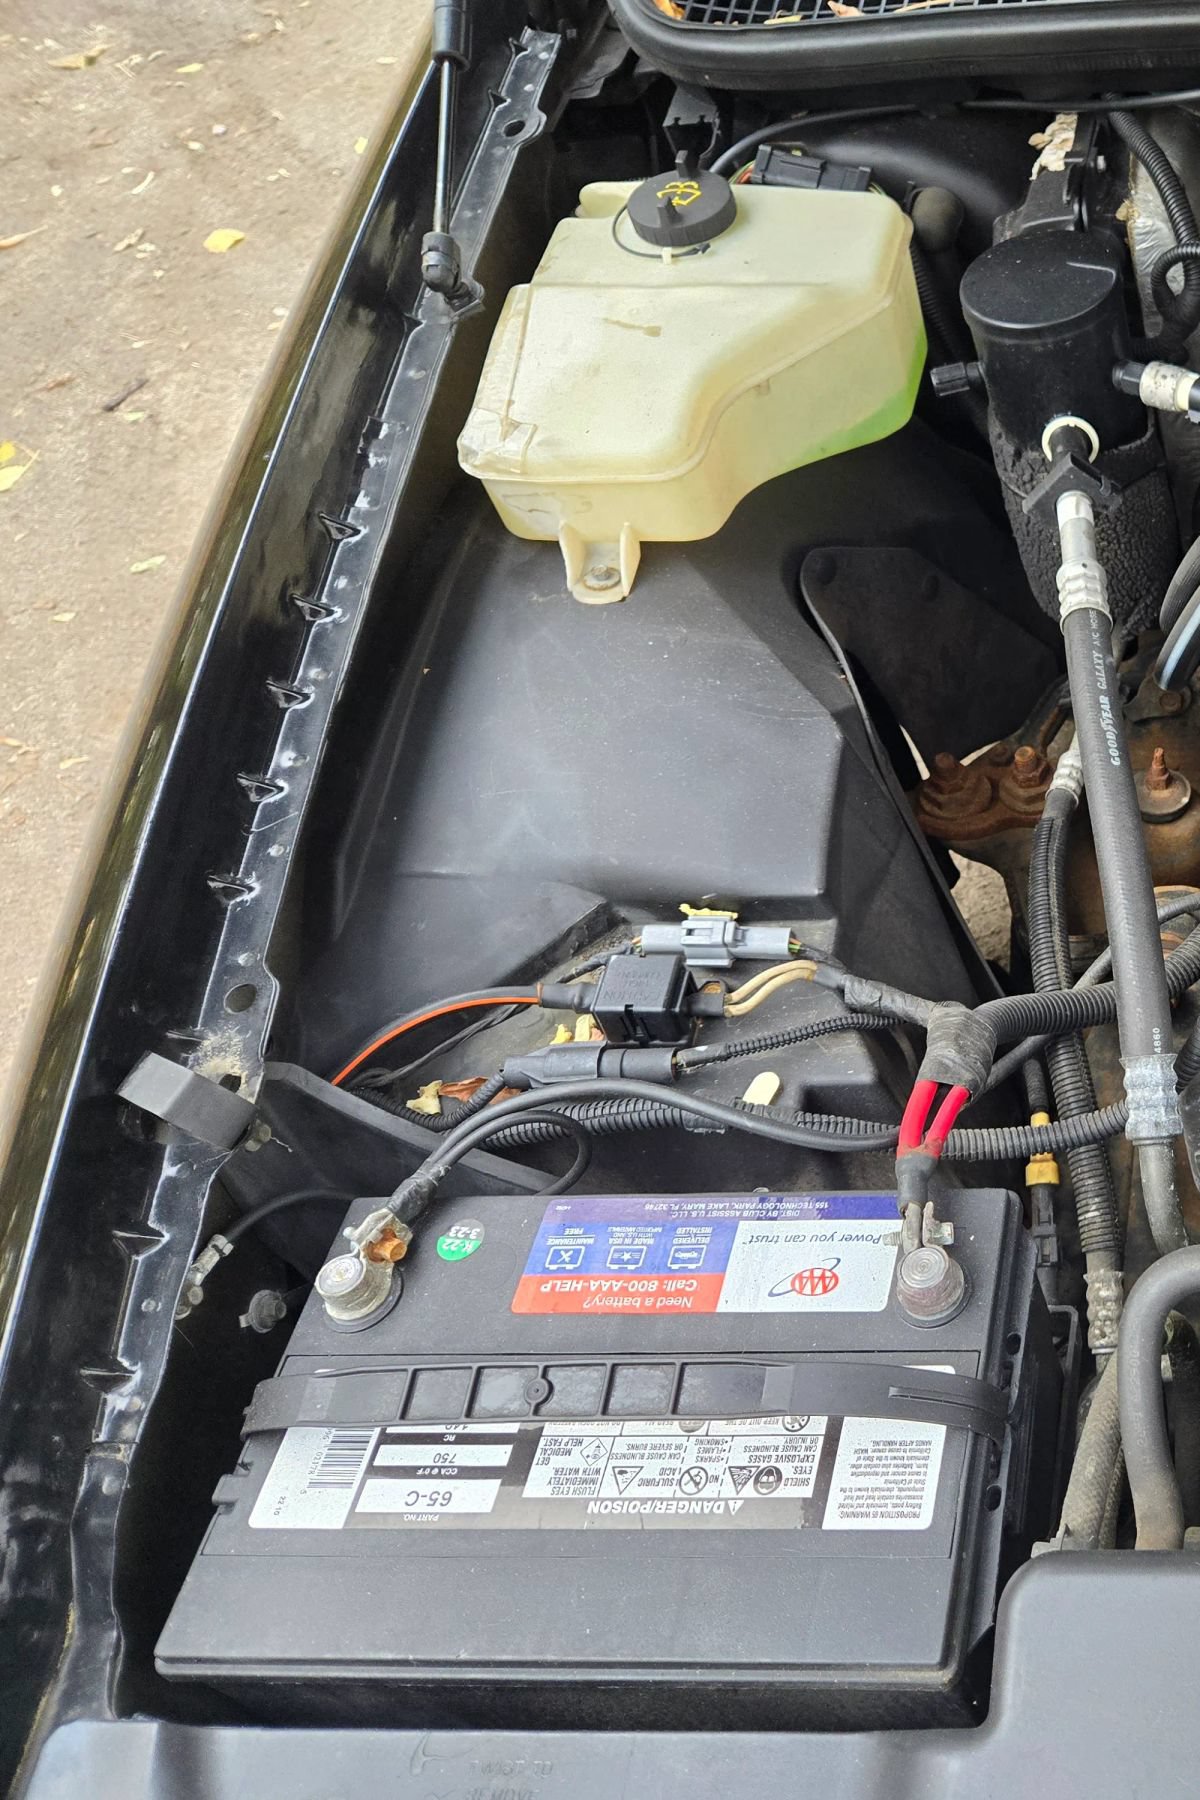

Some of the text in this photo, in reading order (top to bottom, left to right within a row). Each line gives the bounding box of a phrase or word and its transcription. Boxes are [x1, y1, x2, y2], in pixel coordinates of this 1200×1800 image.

[1093, 651, 1107, 689] GALAXY
[1099, 695, 1121, 766] GOODYEAR
[449, 1225, 480, 1239] 3-23
[563, 1227, 584, 1235] FREE
[676, 1226, 712, 1234] INSTALLED
[672, 1236, 710, 1244] DELIVERED
[784, 1234, 806, 1243] can
[809, 1231, 837, 1243] you
[839, 1234, 882, 1244] Power
[540, 1279, 697, 1292] Call: 800-AAA-HELP
[792, 1268, 837, 1296] AAA
[583, 1294, 692, 1308] Need a battery?
[543, 1438, 584, 1447] HELP FAST.
[783, 1436, 819, 1444] OR INJURY.
[649, 1442, 673, 1450] SEVERE
[780, 1444, 803, 1452] CAUSE
[803, 1444, 817, 1452] CAN
[539, 1447, 573, 1456] MEDICAL
[609, 1452, 681, 1460] CAN CAUSE BLINDNESS
[433, 1452, 456, 1464] 750
[535, 1456, 550, 1465] GET
[747, 1454, 815, 1463] EXPLOSIVE GASES
[440, 1467, 458, 1475] CCA
[552, 1467, 601, 1476] WITH WATER.
[659, 1467, 677, 1476] ACID
[791, 1465, 813, 1475] EYES.
[546, 1477, 599, 1486] IMMEDIATELY
[637, 1477, 675, 1486] SULFURIC
[708, 1474, 719, 1483] NO
[783, 1477, 810, 1487] SHIELD
[550, 1486, 596, 1495] FLUSH EYES
[404, 1490, 453, 1507] 65-C
[586, 1500, 725, 1514] DANGER/POISON
[838, 1511, 920, 1519] PROPOSITION 65 WARNING:
